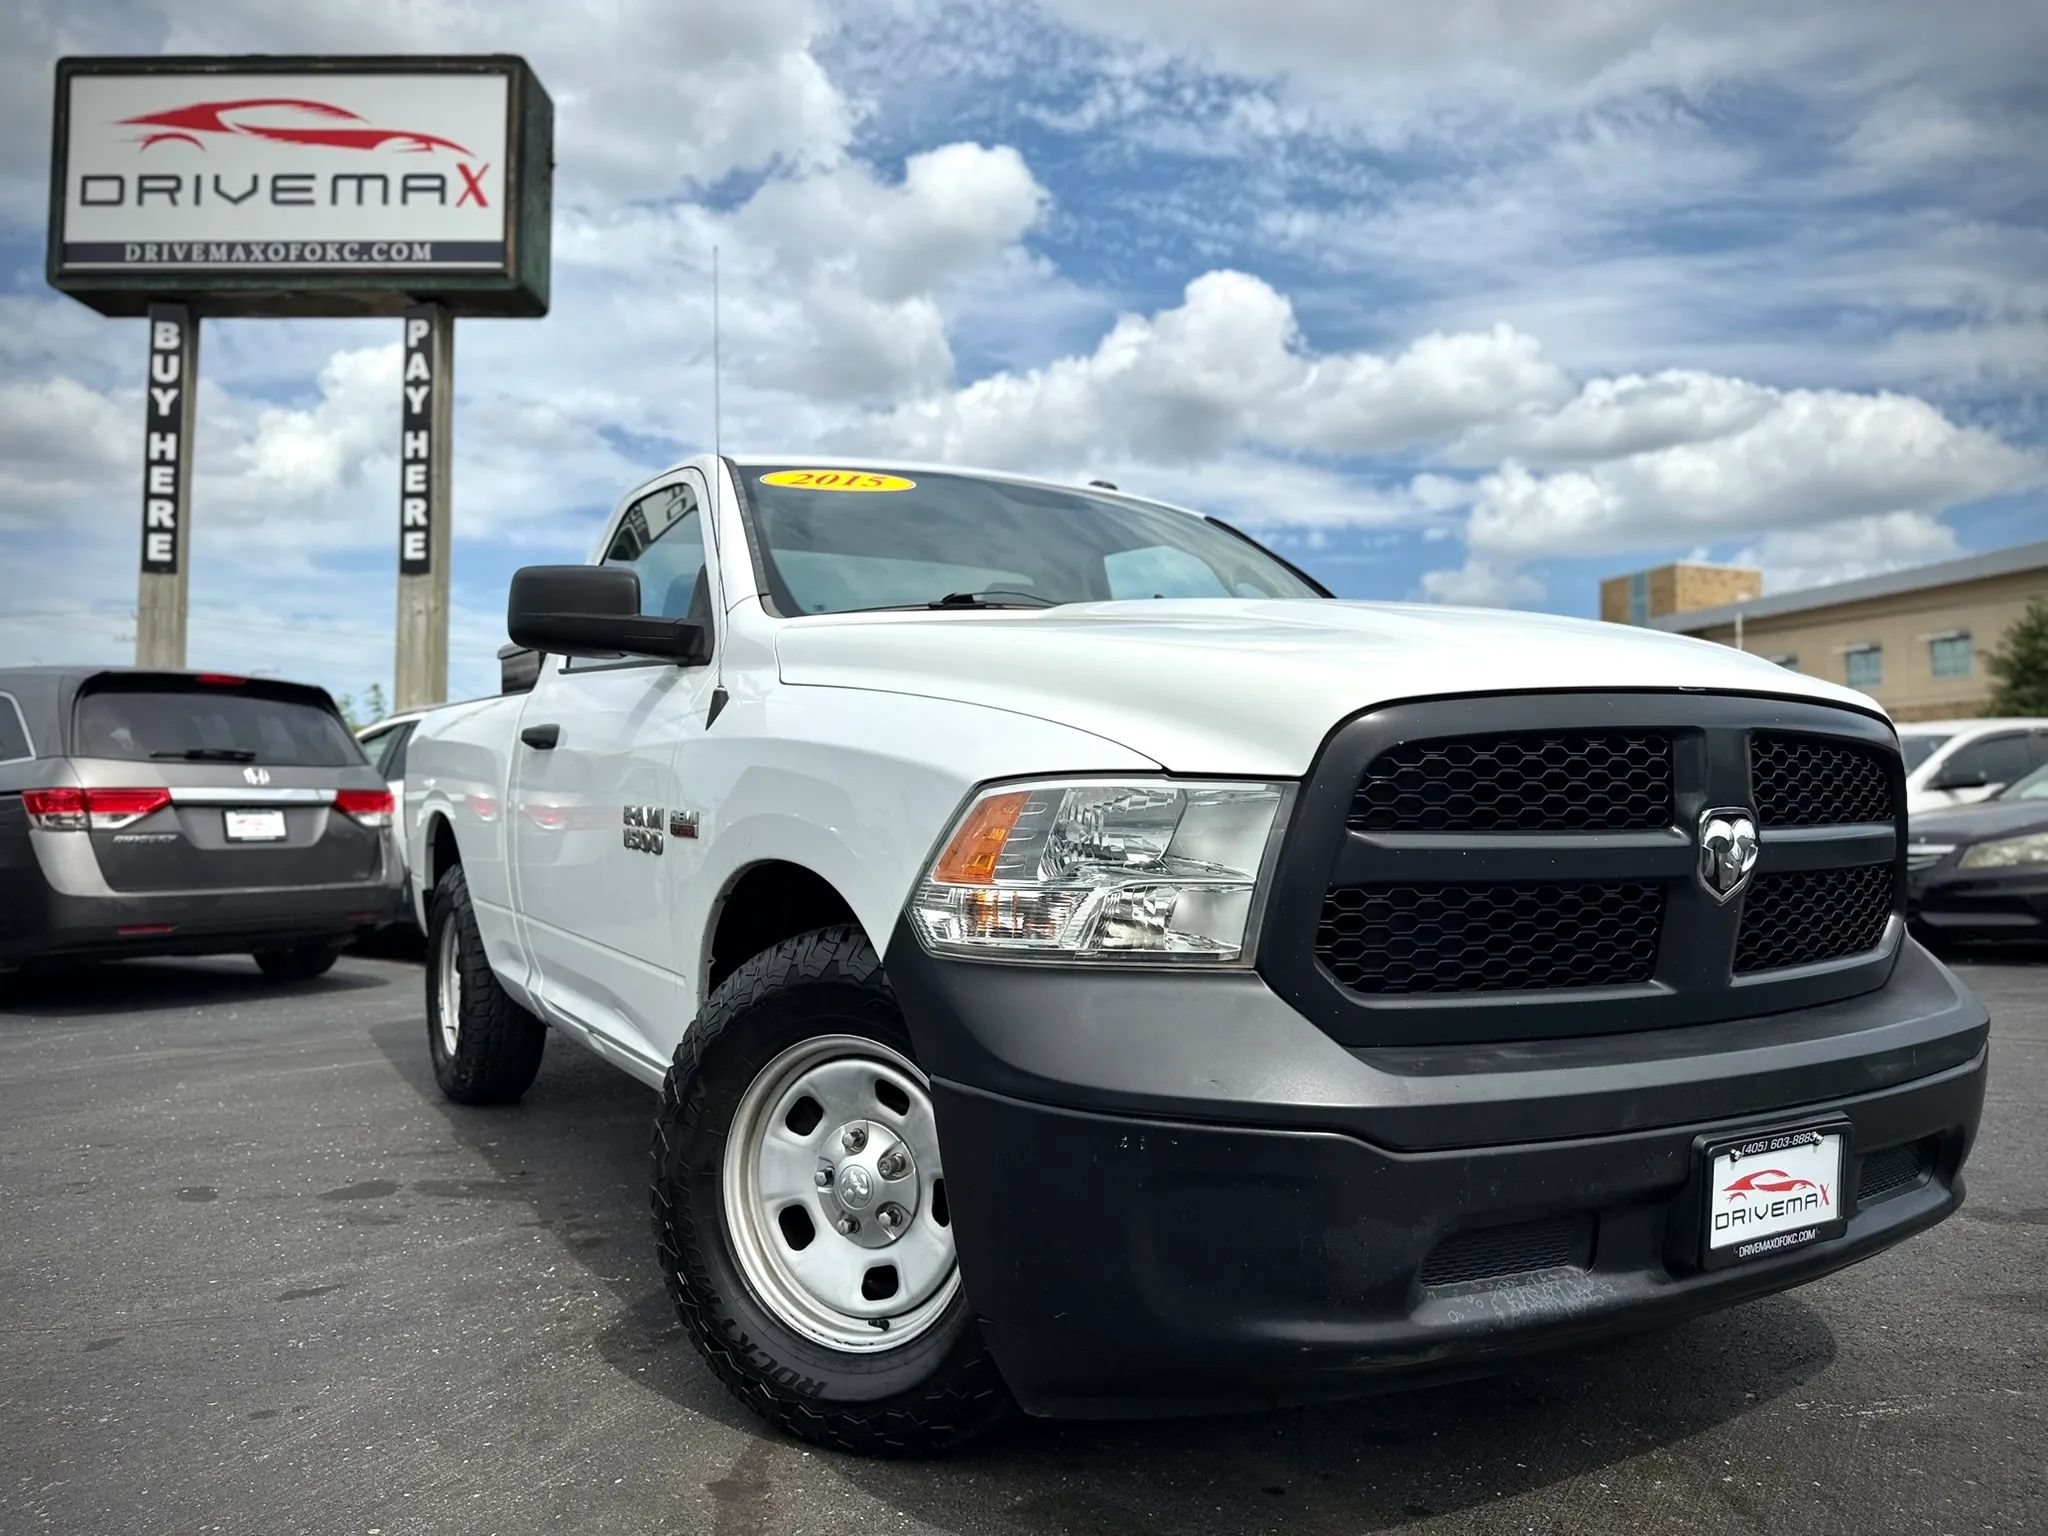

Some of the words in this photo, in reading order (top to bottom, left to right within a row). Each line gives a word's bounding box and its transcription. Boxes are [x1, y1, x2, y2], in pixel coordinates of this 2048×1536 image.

[79, 162, 490, 207] DRIVEMAX
[124, 242, 432, 263] DRIVEMAXOFOKC.COM
[152, 321, 180, 416] BUY
[404, 318, 431, 415] PAY
[147, 432, 178, 562] HERE
[403, 430, 429, 561] HERE
[788, 473, 888, 488] 2015
[623, 827, 664, 856] 1500
[1741, 1140, 1769, 1155] (405)
[1715, 1183, 1830, 1230] DRIVEMAX
[1738, 1228, 1816, 1258] DRIVEMAXOFOKC.COM
